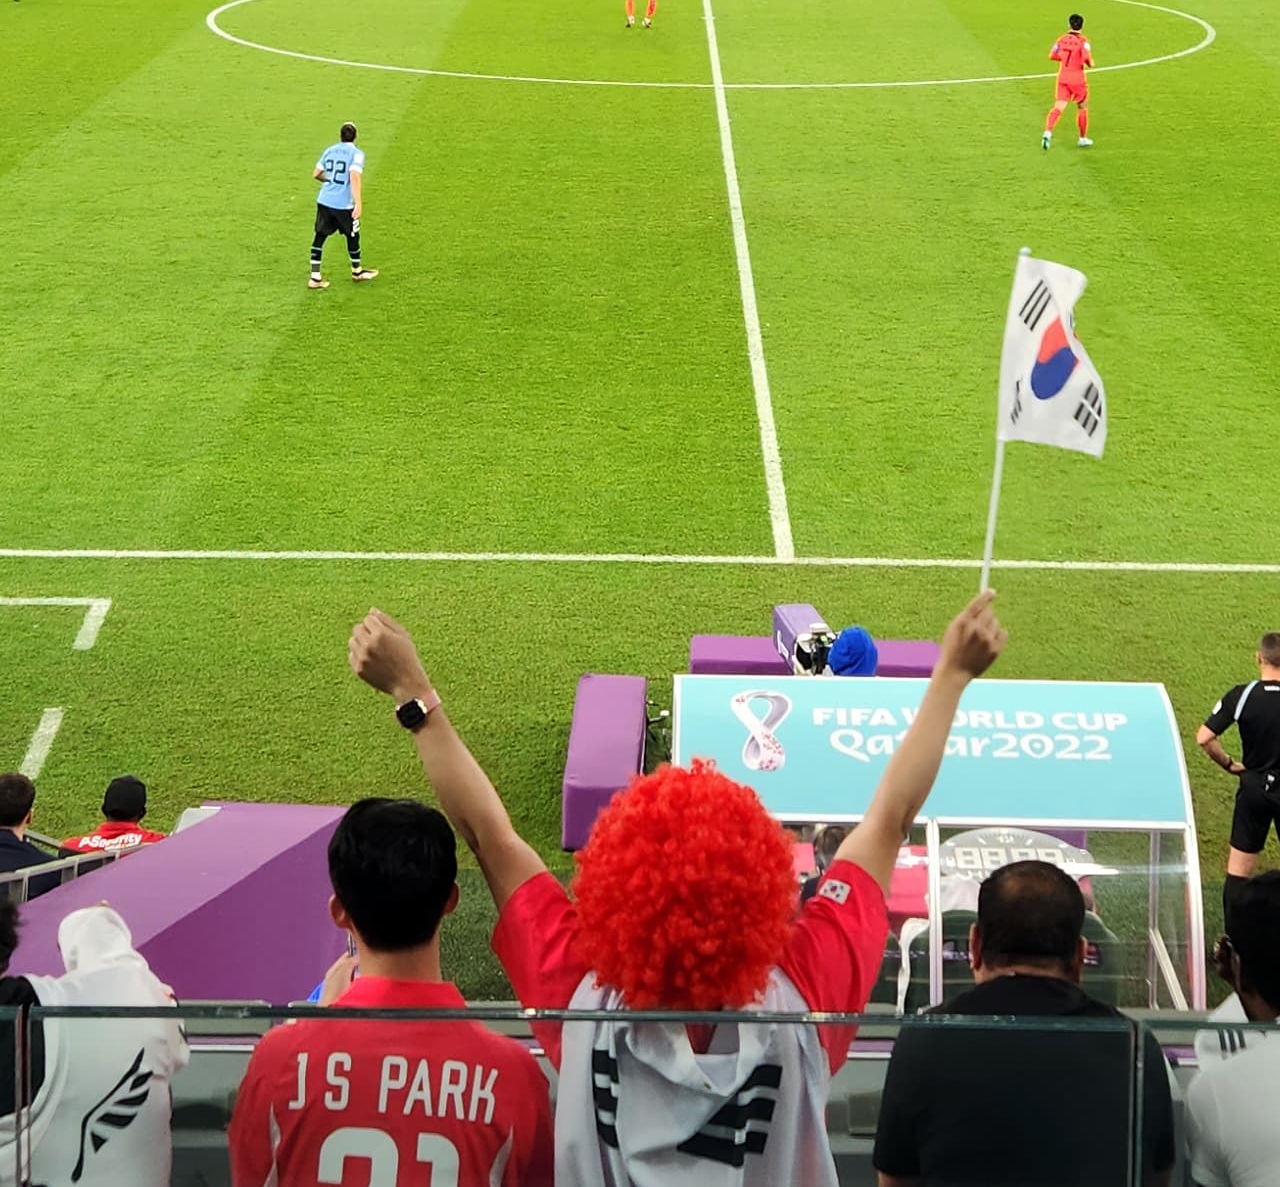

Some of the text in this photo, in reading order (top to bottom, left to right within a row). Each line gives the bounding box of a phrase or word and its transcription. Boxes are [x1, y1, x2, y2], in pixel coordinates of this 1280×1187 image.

[1063, 49, 1072, 67] 7
[812, 708, 898, 727] FIFA
[1051, 712, 1127, 731] CUP
[289, 1052, 499, 1125] J S PARK
